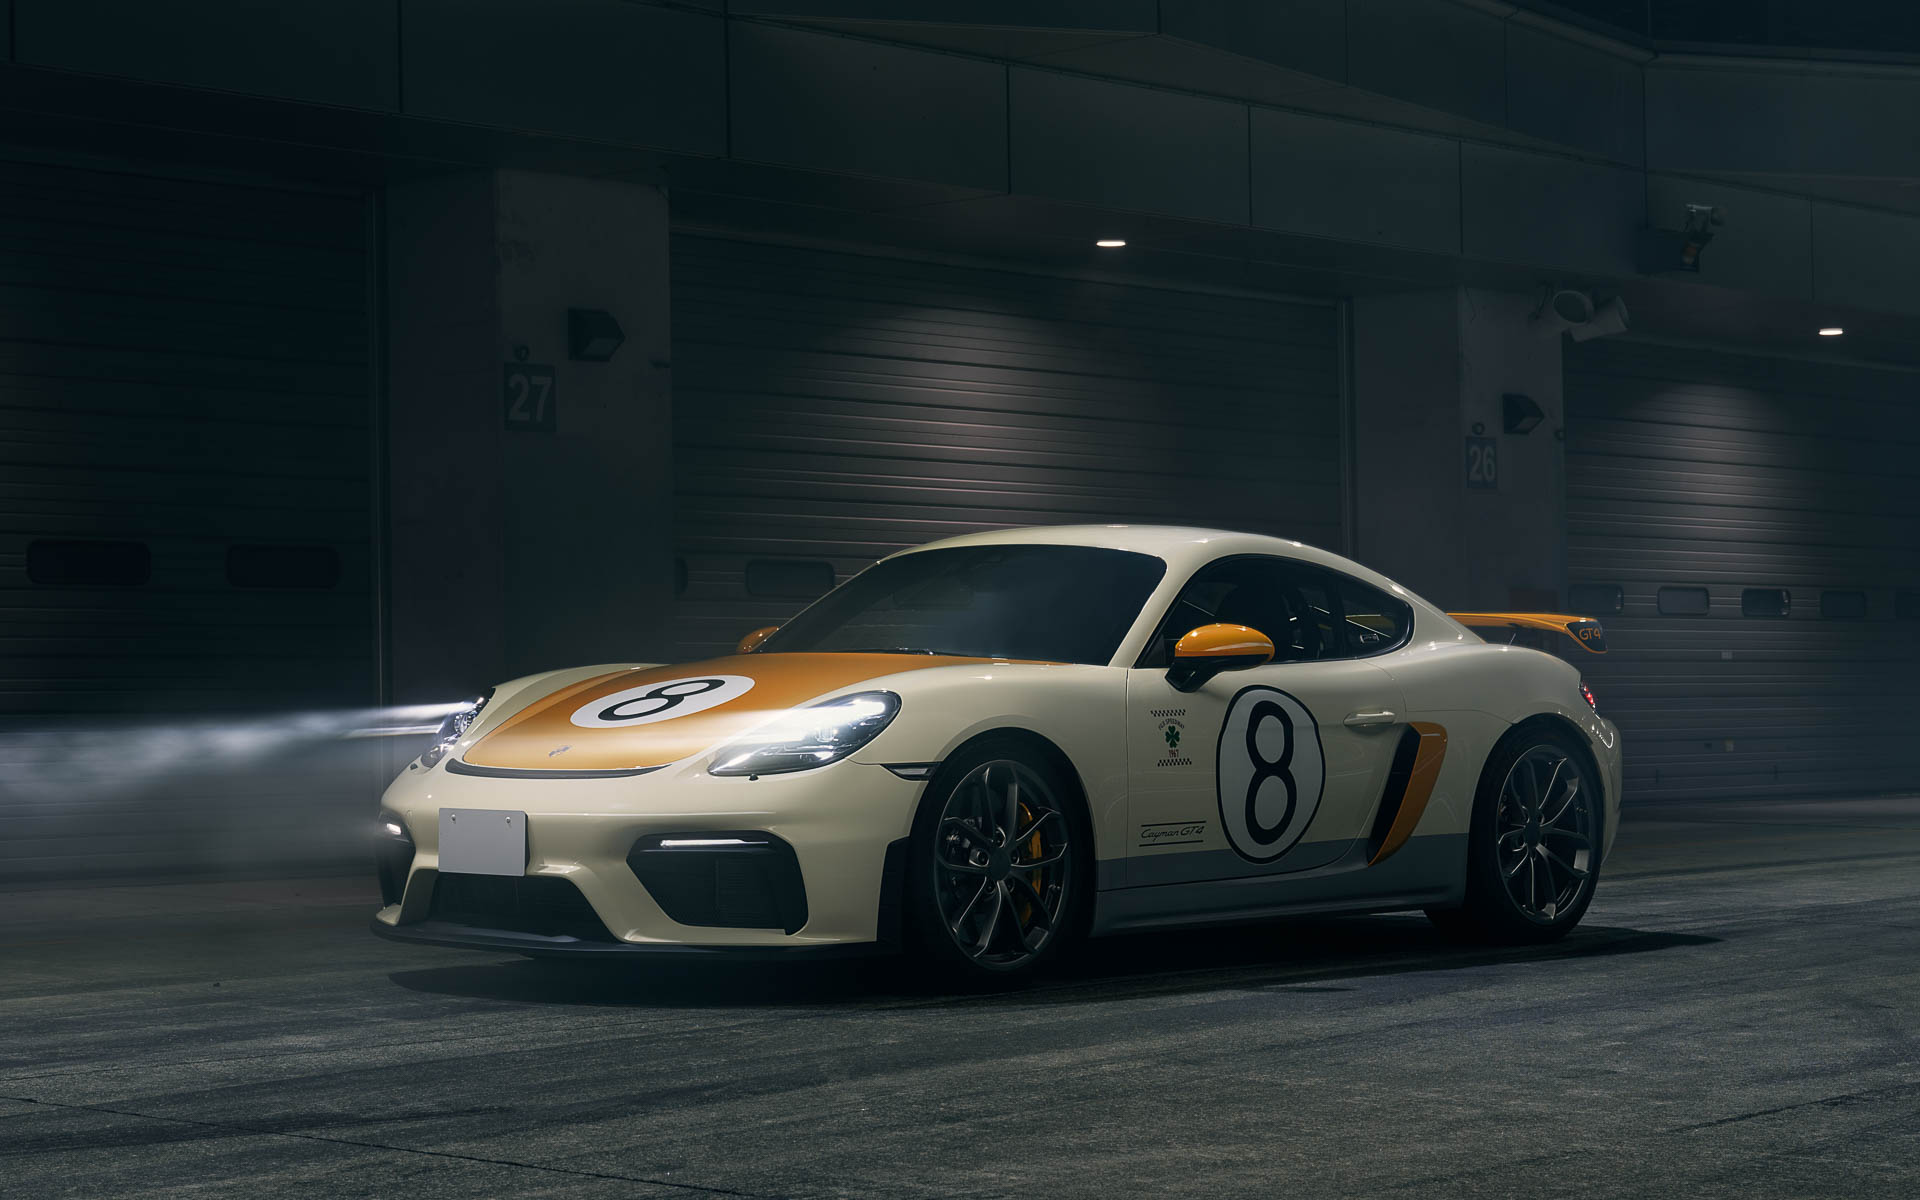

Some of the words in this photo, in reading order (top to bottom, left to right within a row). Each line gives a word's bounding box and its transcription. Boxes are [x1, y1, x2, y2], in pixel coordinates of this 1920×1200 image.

[509, 374, 552, 422] 27
[1469, 445, 1495, 481] 26
[1579, 627, 1601, 641] GT4
[598, 679, 725, 721] 8
[1245, 700, 1297, 845] 8
[1141, 828, 1179, 842] Cayman
[1181, 825, 1205, 836] GT4
